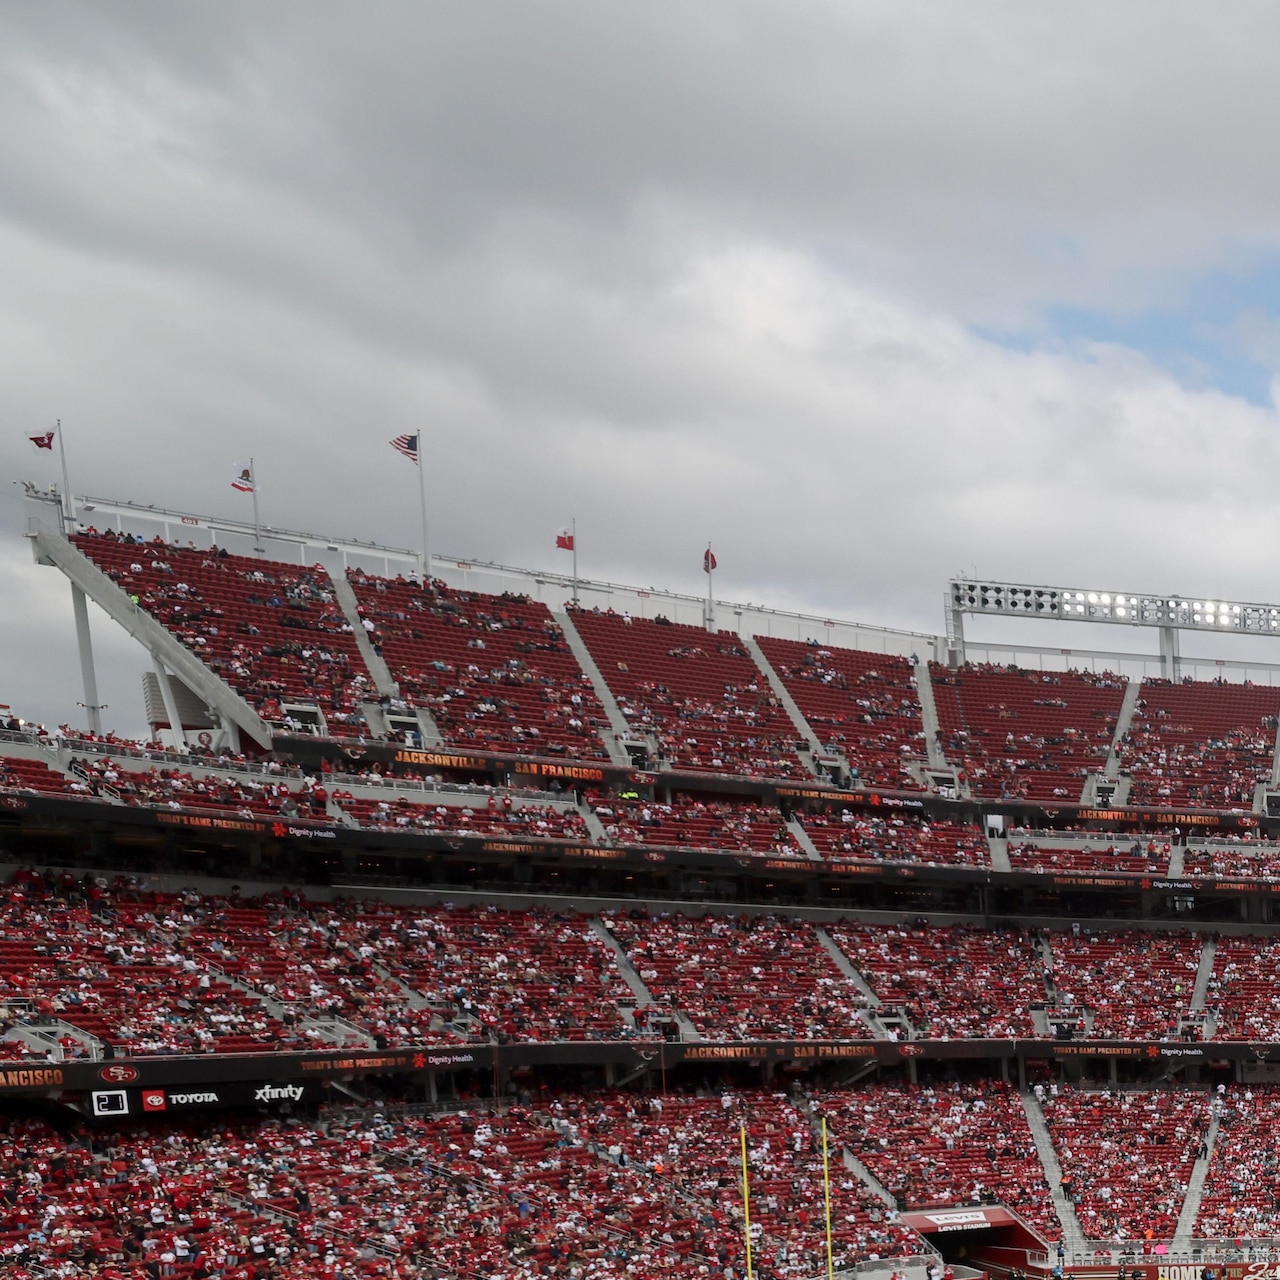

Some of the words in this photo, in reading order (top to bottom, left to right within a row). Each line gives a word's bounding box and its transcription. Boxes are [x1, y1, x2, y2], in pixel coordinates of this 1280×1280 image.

[395, 751, 486, 769] JACKSONVILLE
[515, 762, 538, 774] SAN
[541, 764, 603, 780] FRANCISCO
[882, 798, 903, 806] Dignity
[1076, 810, 1138, 821] JACKSONVILLE
[1157, 814, 1173, 823] SAN
[1175, 815, 1220, 825] FRANCISCO
[289, 827, 313, 838] Dignity
[314, 830, 336, 839] Health
[683, 1047, 767, 1058] JACKSONVILLE
[794, 1047, 815, 1057] SAN
[818, 1046, 875, 1057] FRANCISCO
[1161, 1048, 1182, 1057] Dignity
[428, 1055, 452, 1065] Dignity
[168, 1092, 219, 1104] TOYOTA
[254, 1083, 304, 1103] xfinity
[98, 1095, 123, 1111] 21
[963, 1222, 991, 1231] STADIUM
